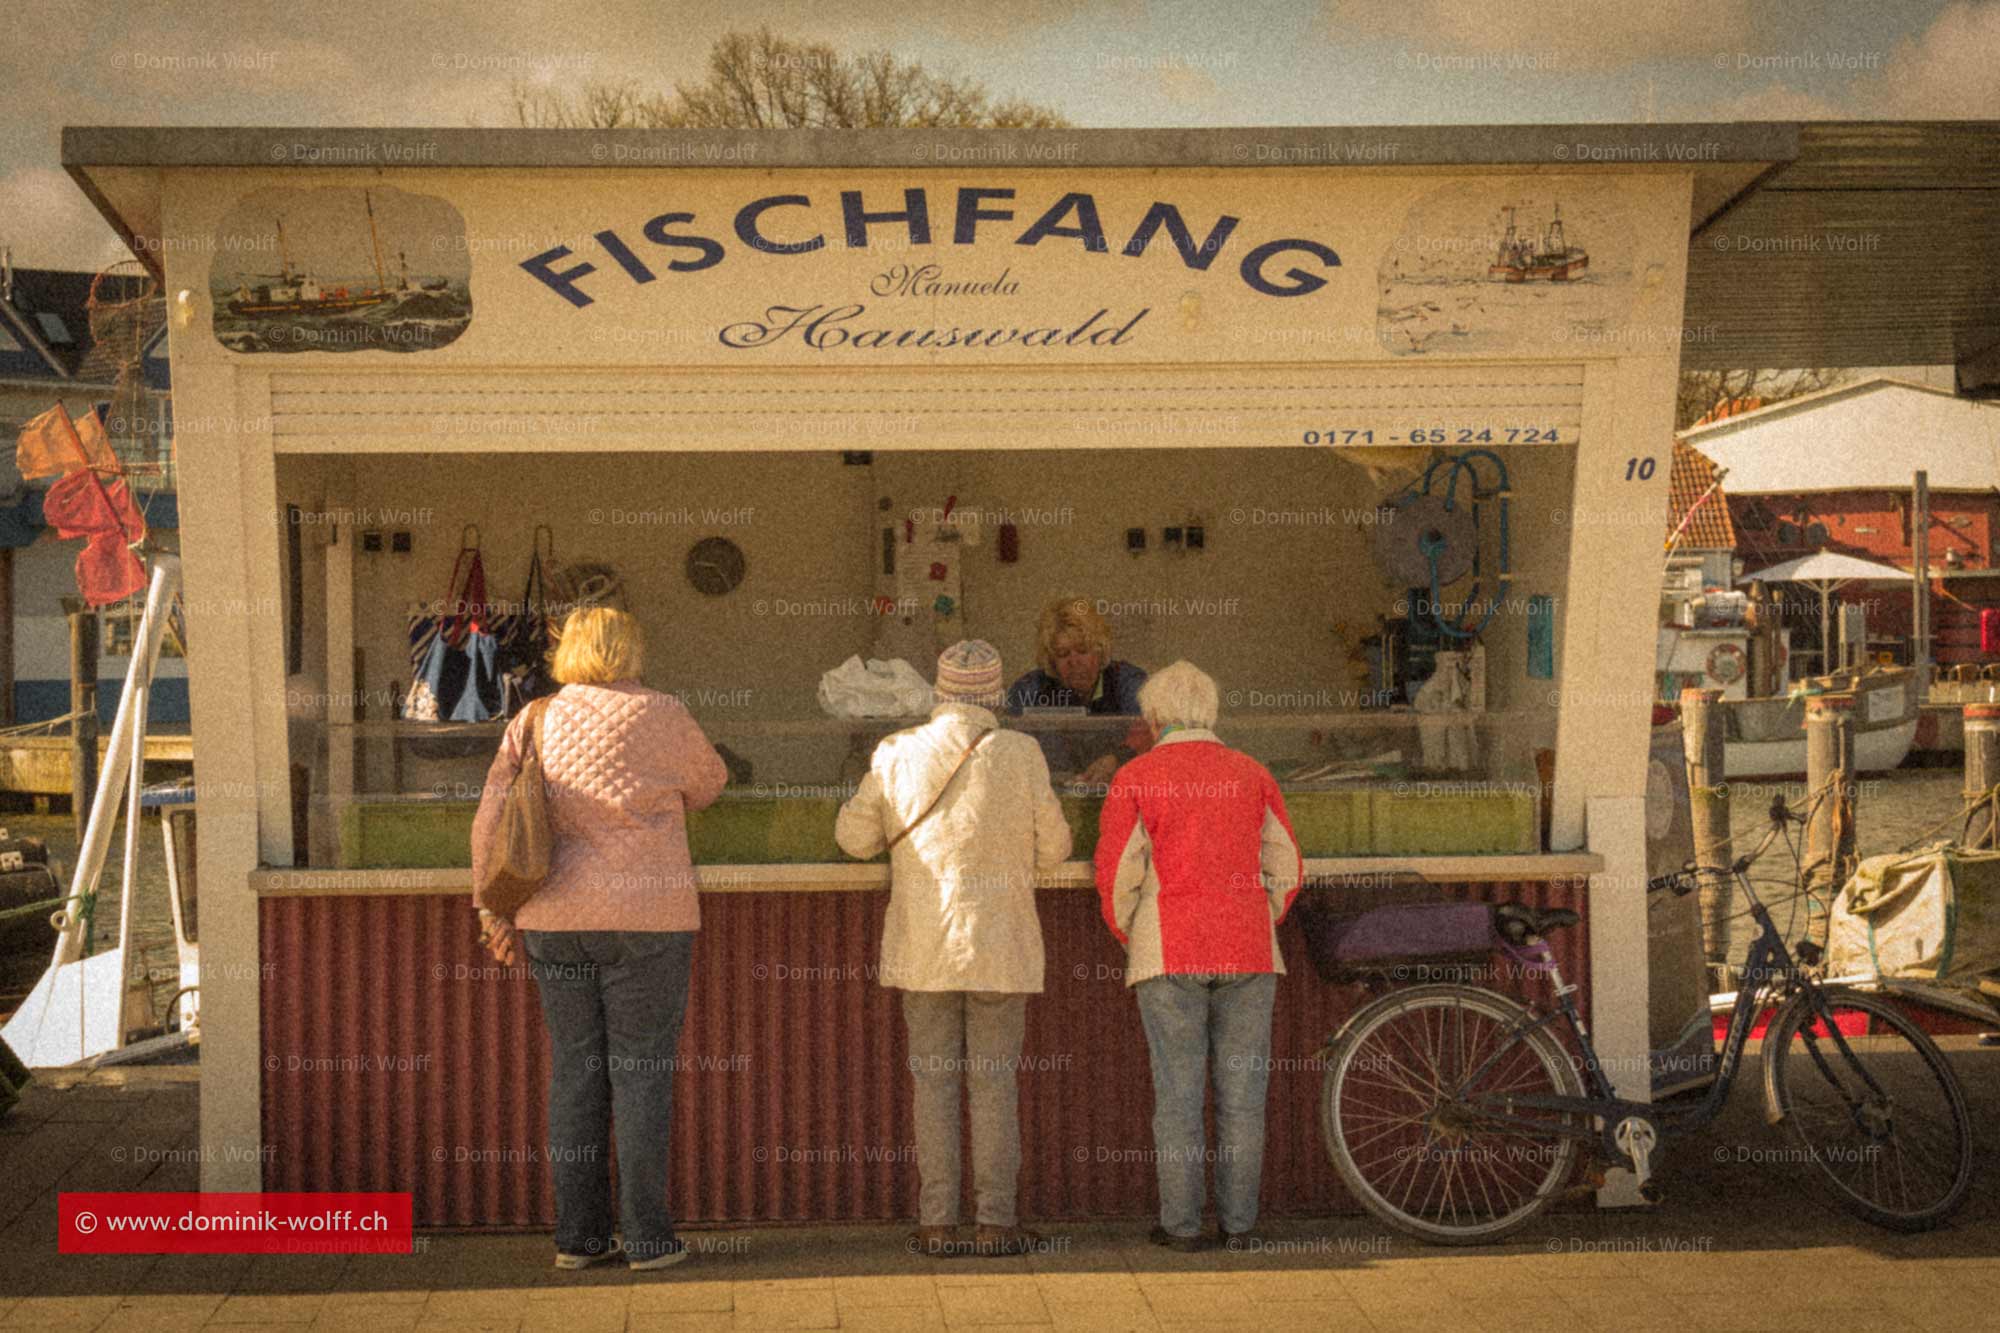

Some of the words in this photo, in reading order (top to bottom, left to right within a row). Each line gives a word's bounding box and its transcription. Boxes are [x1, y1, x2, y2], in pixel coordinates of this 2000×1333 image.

[520, 188, 1341, 308] FISCHFANG
[870, 264, 1019, 297] Manuela
[718, 304, 1151, 351] Hauswald
[1303, 429, 1374, 445] 0171
[1409, 428, 1446, 443] 65
[1457, 428, 1492, 443] 24
[1504, 427, 1559, 443] 724
[1625, 457, 1655, 480] 10
